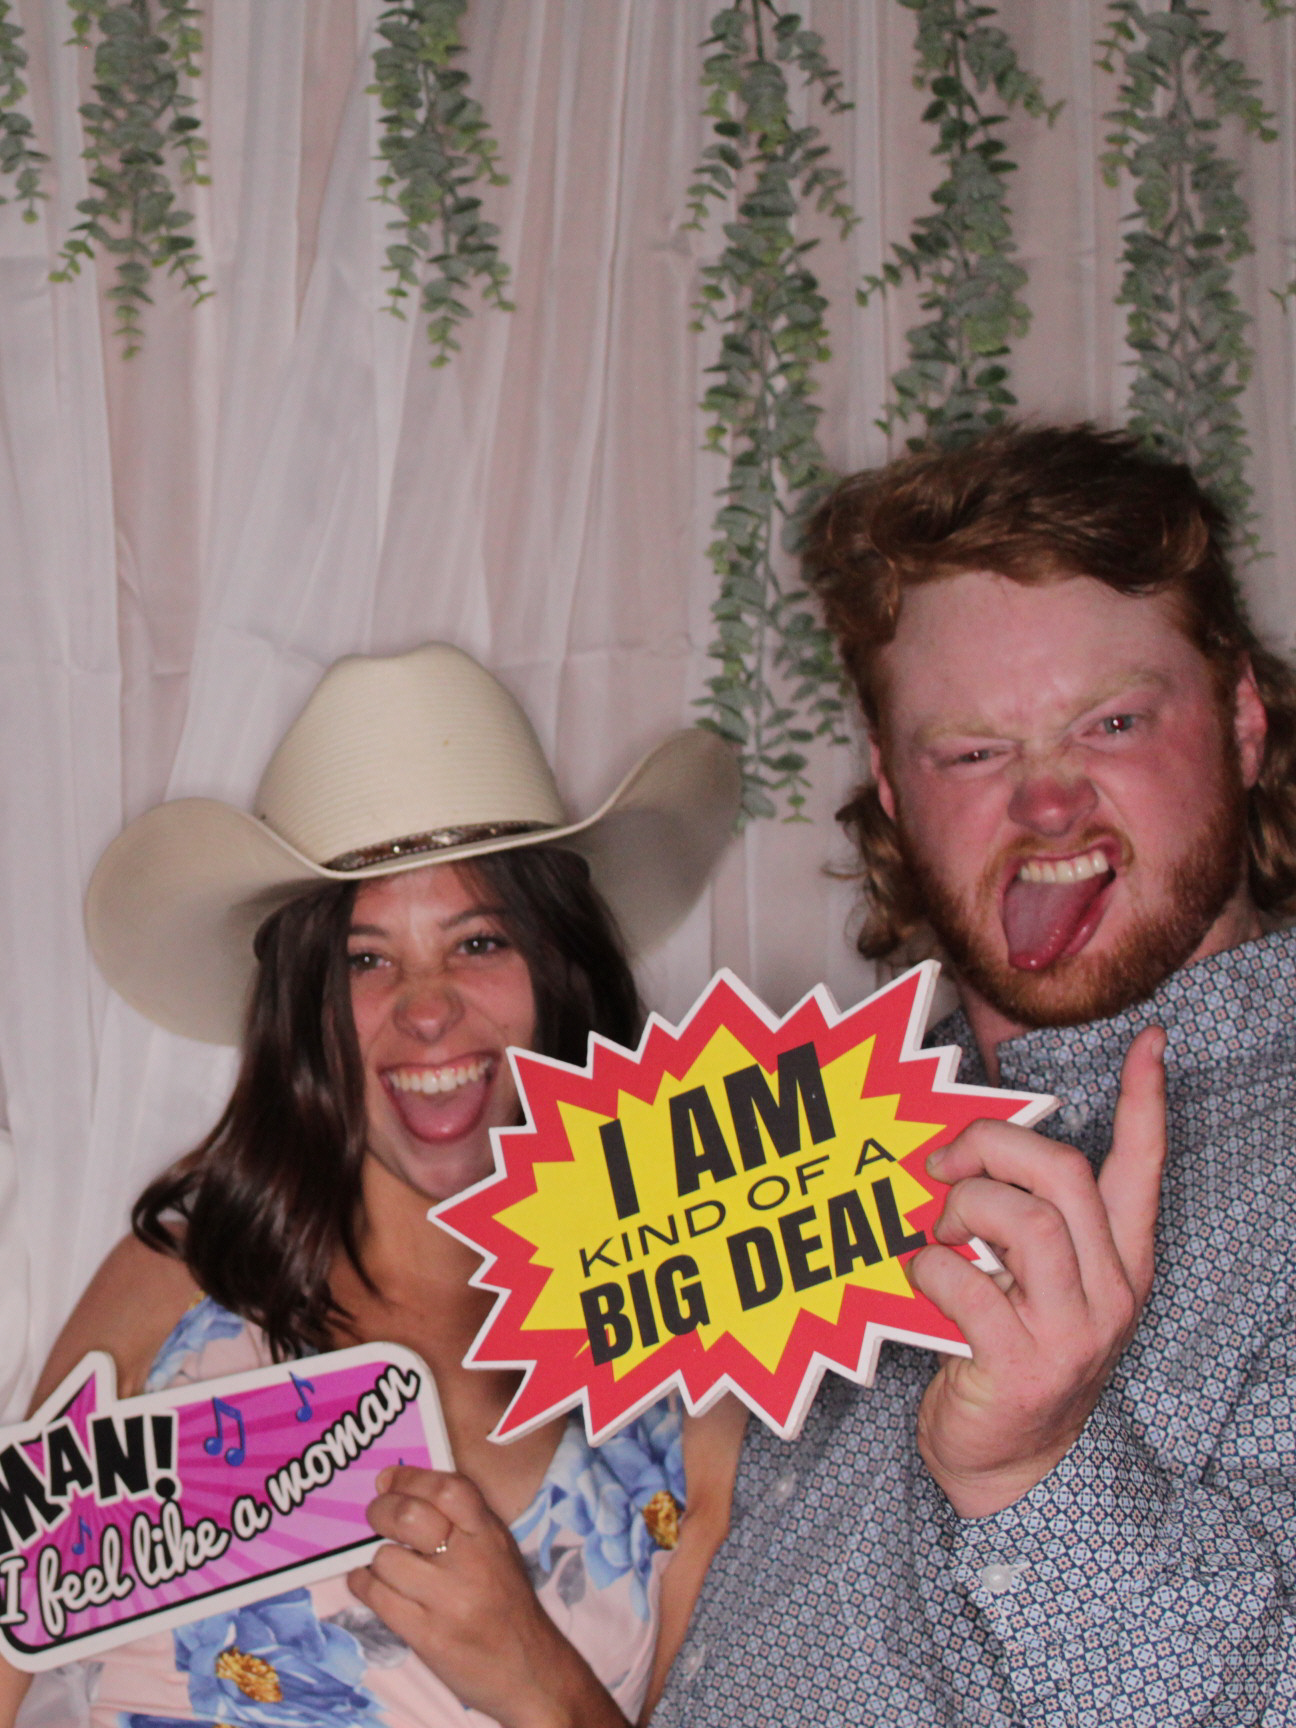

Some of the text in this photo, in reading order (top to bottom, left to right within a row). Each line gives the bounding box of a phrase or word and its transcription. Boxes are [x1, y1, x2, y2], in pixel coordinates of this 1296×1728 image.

[578, 1137, 899, 1278] KIND OF A
[598, 1041, 837, 1220] I AM
[579, 1177, 928, 1367] BIG DEAL
[36, 1523, 134, 1638] feel
[130, 1499, 232, 1588] like
[230, 1494, 272, 1541] a
[265, 1363, 422, 1515] woman
